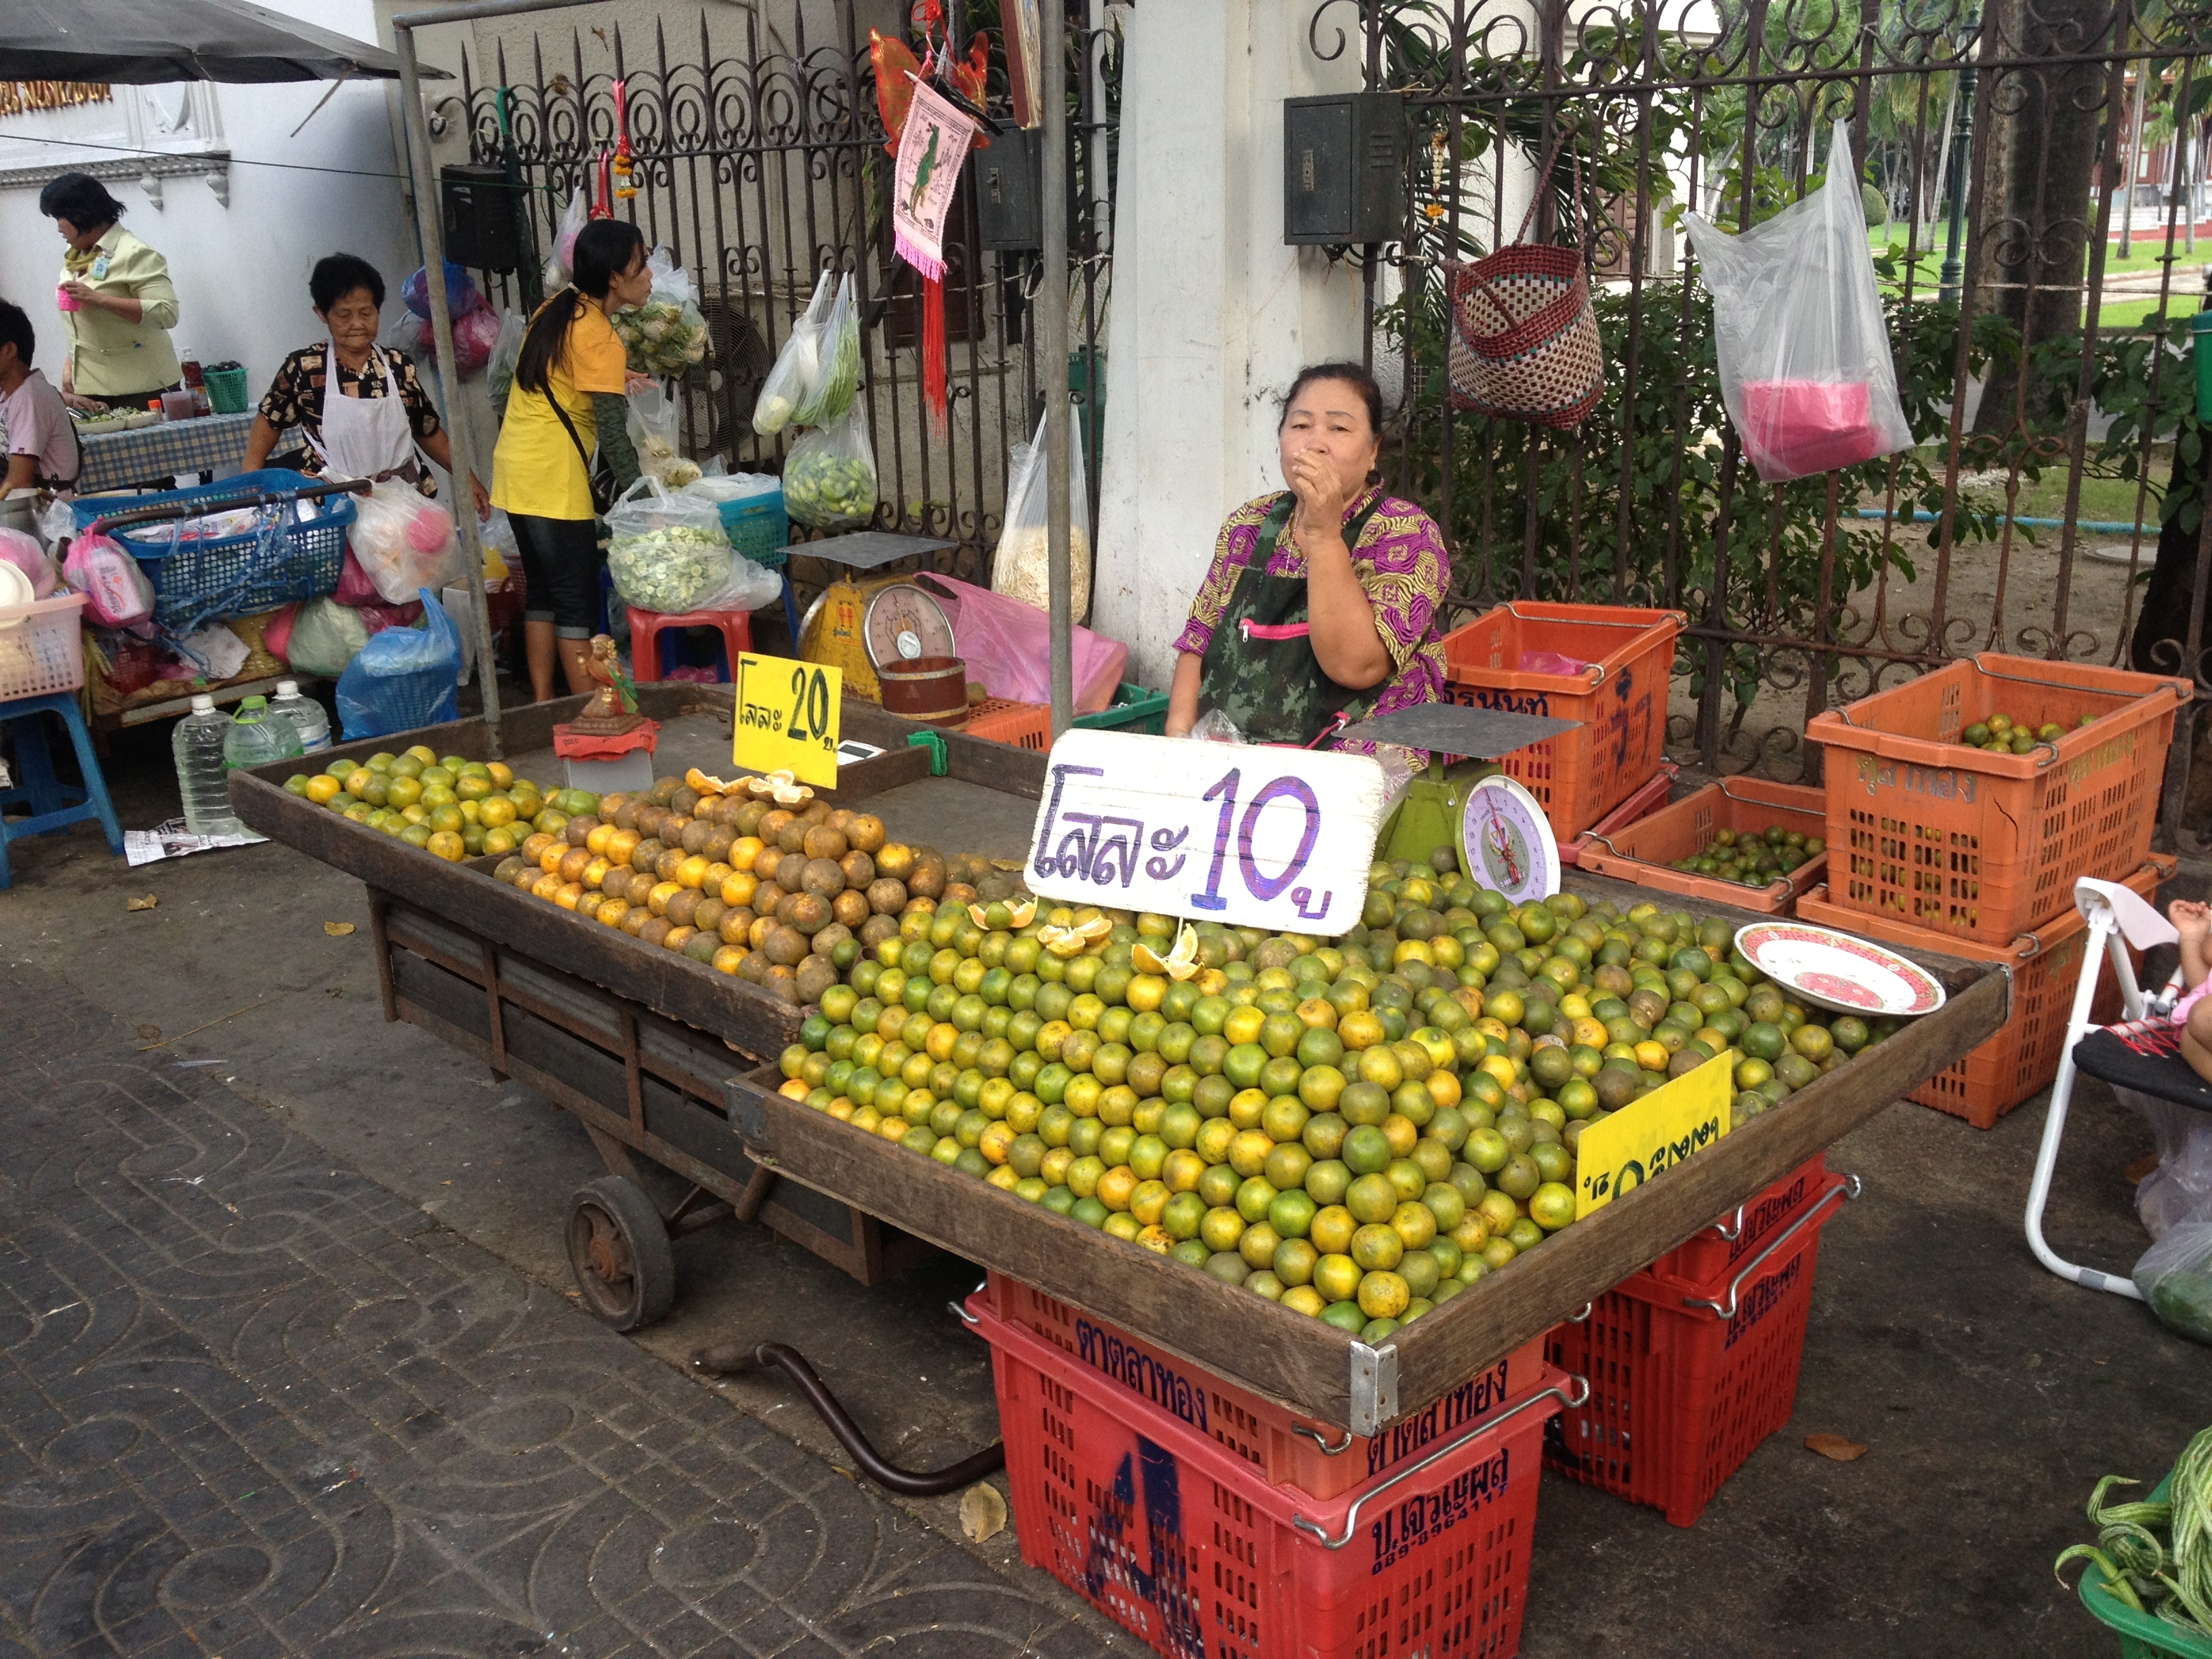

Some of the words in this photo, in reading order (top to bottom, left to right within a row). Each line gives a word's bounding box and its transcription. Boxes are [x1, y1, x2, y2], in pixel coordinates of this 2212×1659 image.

[787, 667, 829, 741] 20
[1033, 764, 1189, 888] โลละ
[1191, 767, 1321, 911] 10
